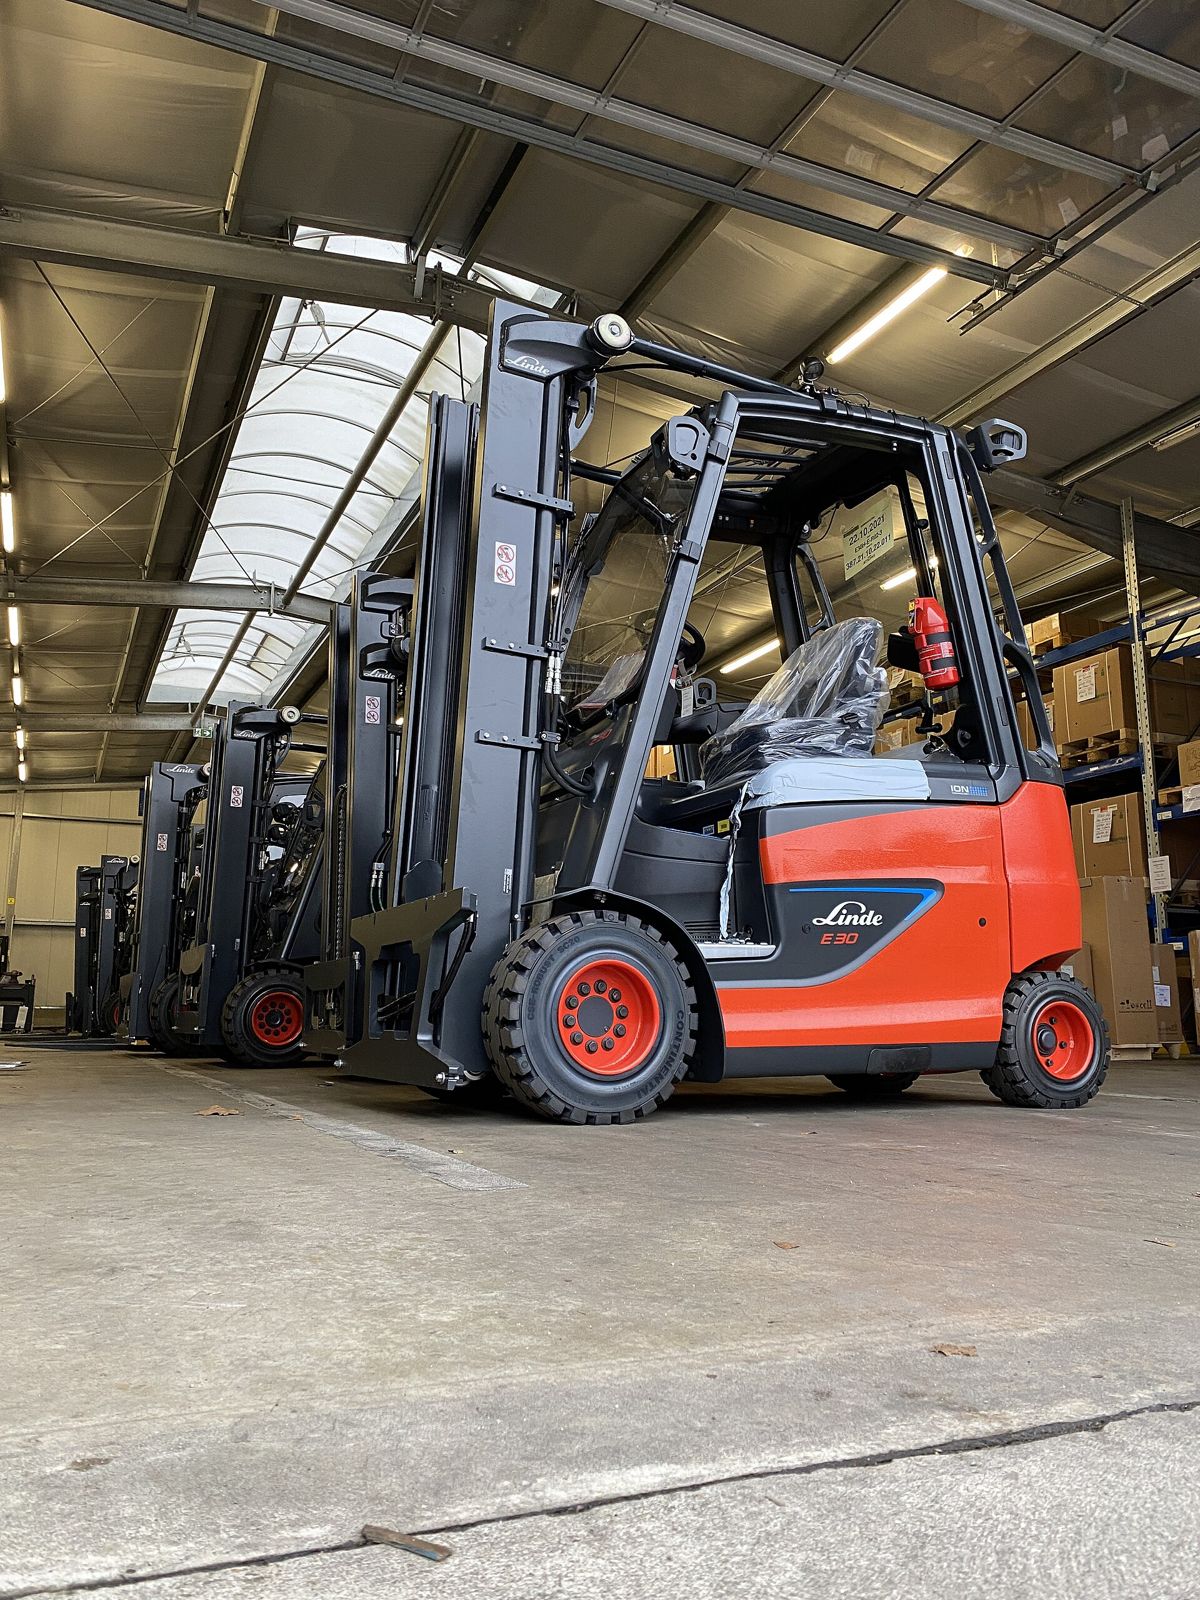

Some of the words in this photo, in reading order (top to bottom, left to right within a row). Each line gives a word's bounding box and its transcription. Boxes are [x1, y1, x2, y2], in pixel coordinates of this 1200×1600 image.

[504, 355, 550, 375] Linde
[849, 514, 884, 546] 22.10.2021
[363, 668, 395, 680] Linde
[234, 729, 260, 739] Linde
[166, 764, 195, 774] Linde
[950, 784, 969, 793] ION
[812, 901, 883, 926] Linde
